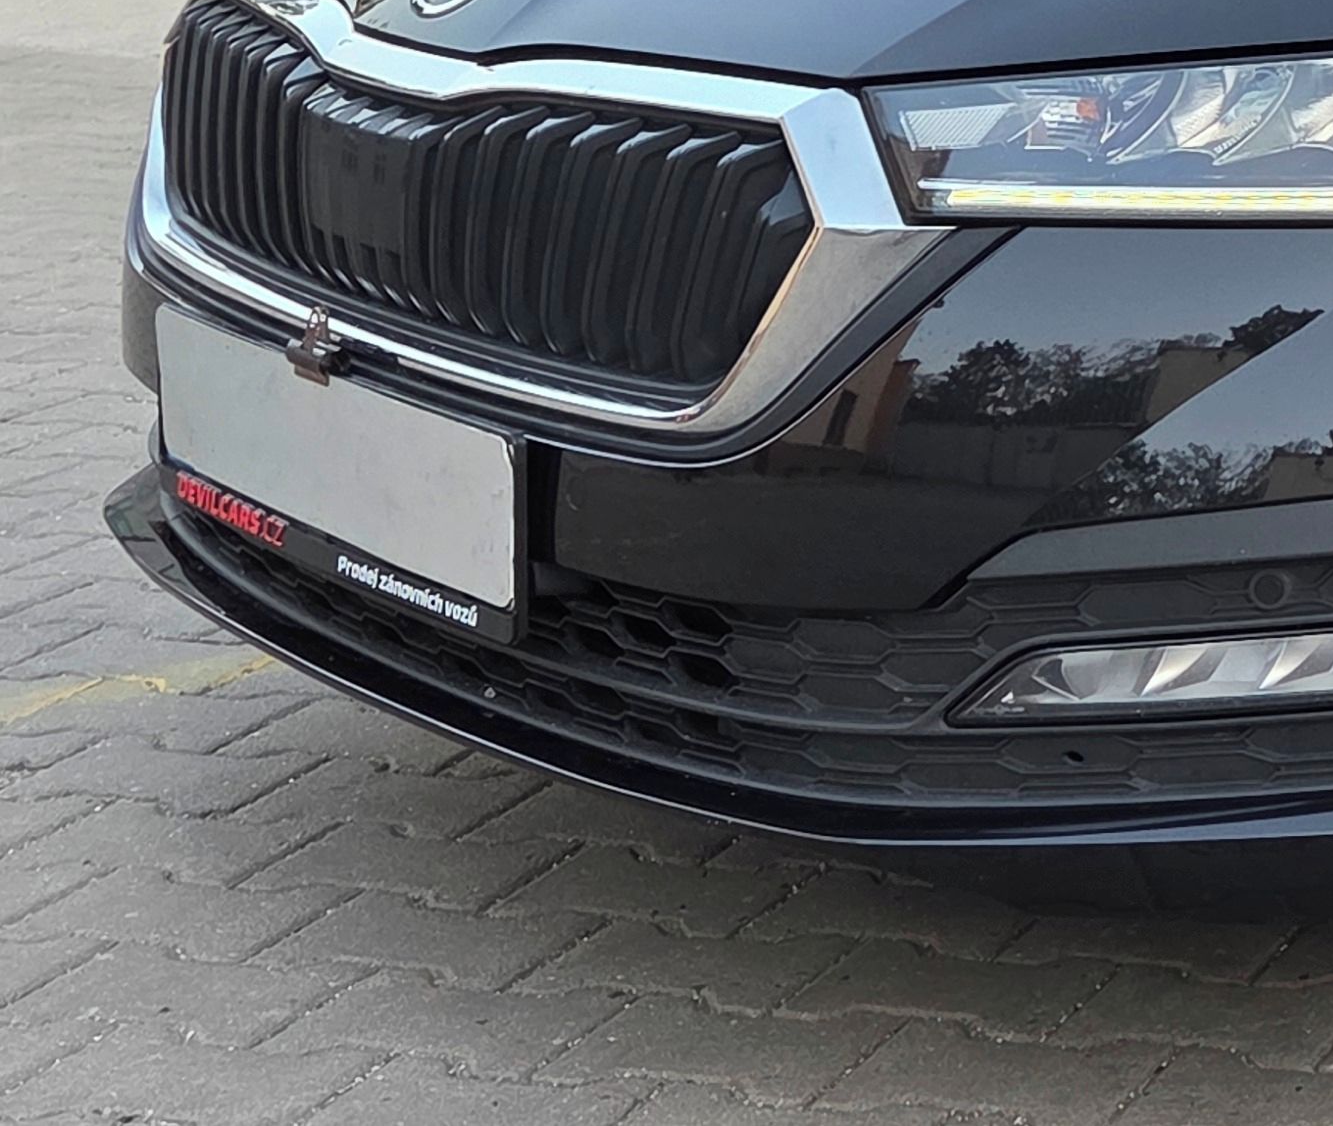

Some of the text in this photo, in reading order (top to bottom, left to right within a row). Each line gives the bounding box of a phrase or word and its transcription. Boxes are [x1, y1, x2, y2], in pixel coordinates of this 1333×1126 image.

[177, 471, 289, 548] DEVILCARS.CZ
[337, 555, 478, 627] Prodej zánovních vozů
